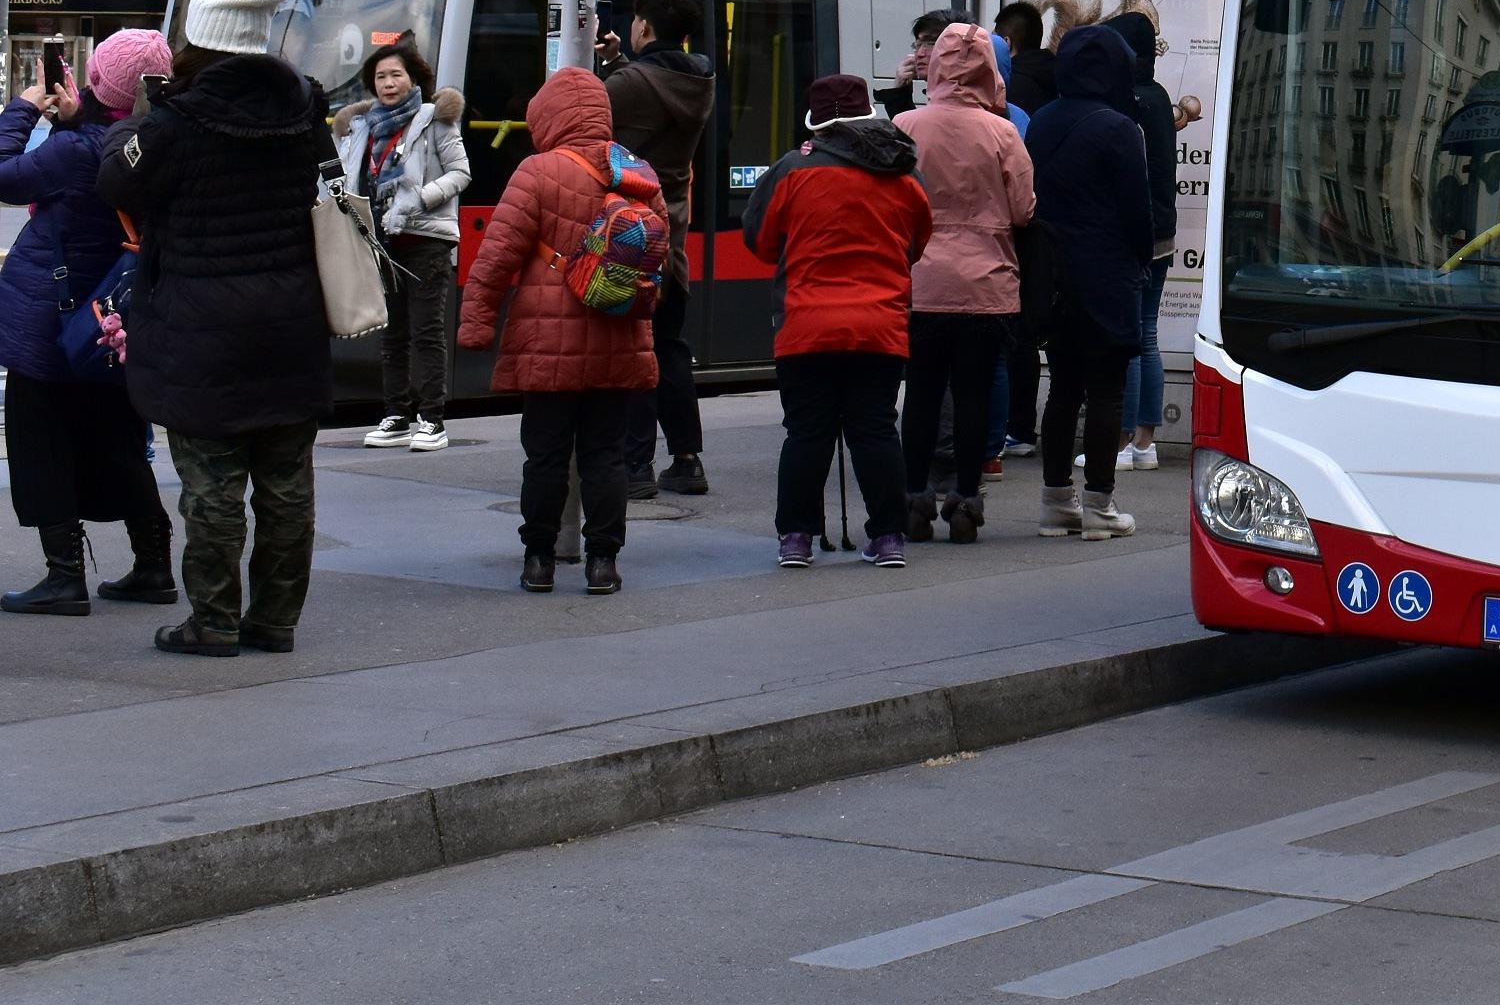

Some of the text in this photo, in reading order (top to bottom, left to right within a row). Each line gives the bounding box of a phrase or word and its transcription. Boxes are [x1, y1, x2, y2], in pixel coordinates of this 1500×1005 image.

[1166, 300, 1188, 309] Energie
[1160, 310, 1200, 318] Gasspeichern
[1489, 624, 1498, 635] A
